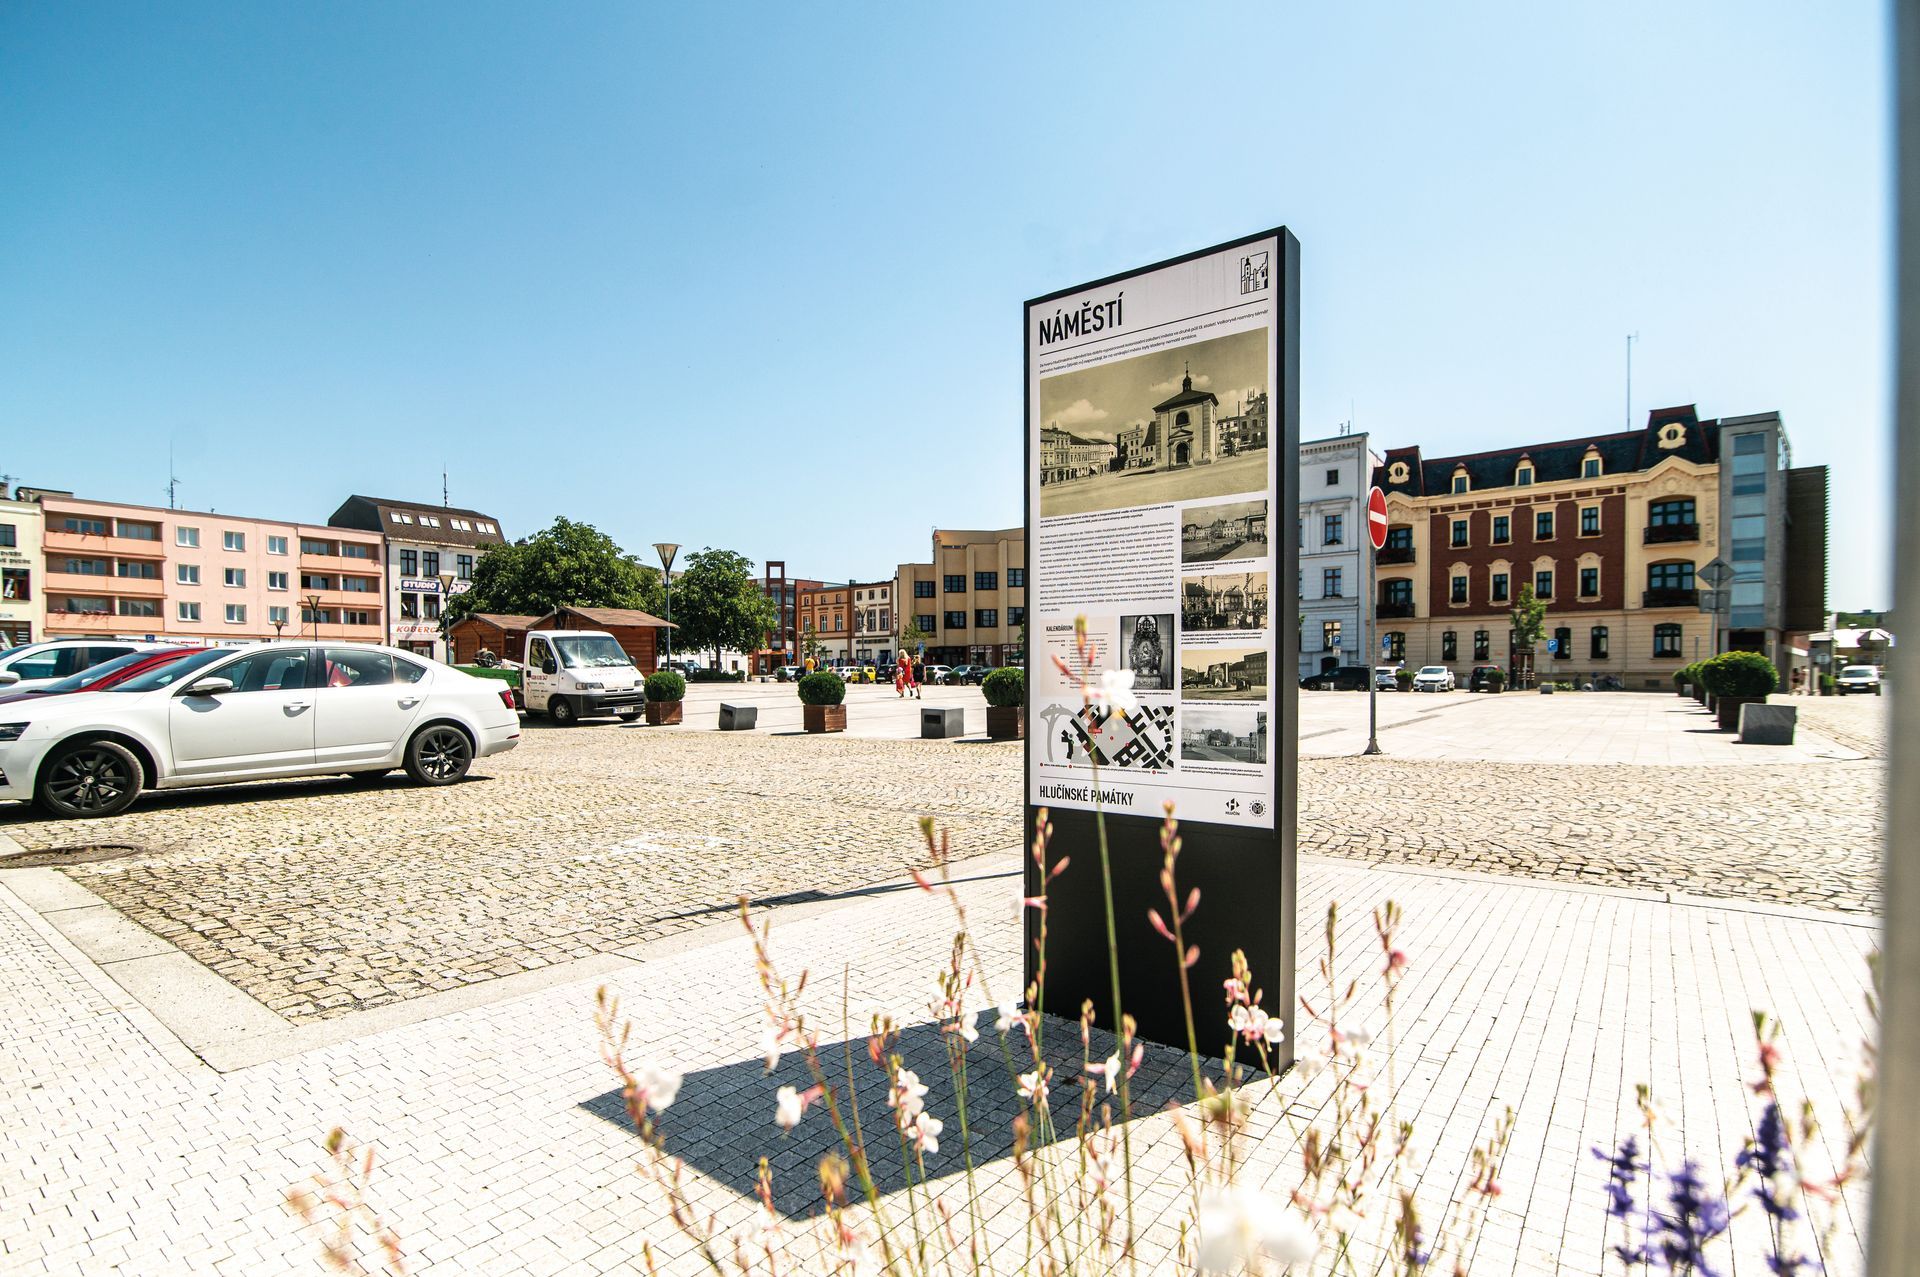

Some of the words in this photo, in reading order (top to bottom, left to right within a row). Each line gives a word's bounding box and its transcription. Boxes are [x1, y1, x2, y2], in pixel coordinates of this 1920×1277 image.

[1039, 292, 1124, 346] NÁMĚSTÍ
[403, 581, 437, 589] STUDIO
[1549, 640, 1556, 649] P
[1039, 784, 1088, 802] HLUČÍNSKÉ
[1090, 788, 1134, 806] PAMÁTKY
